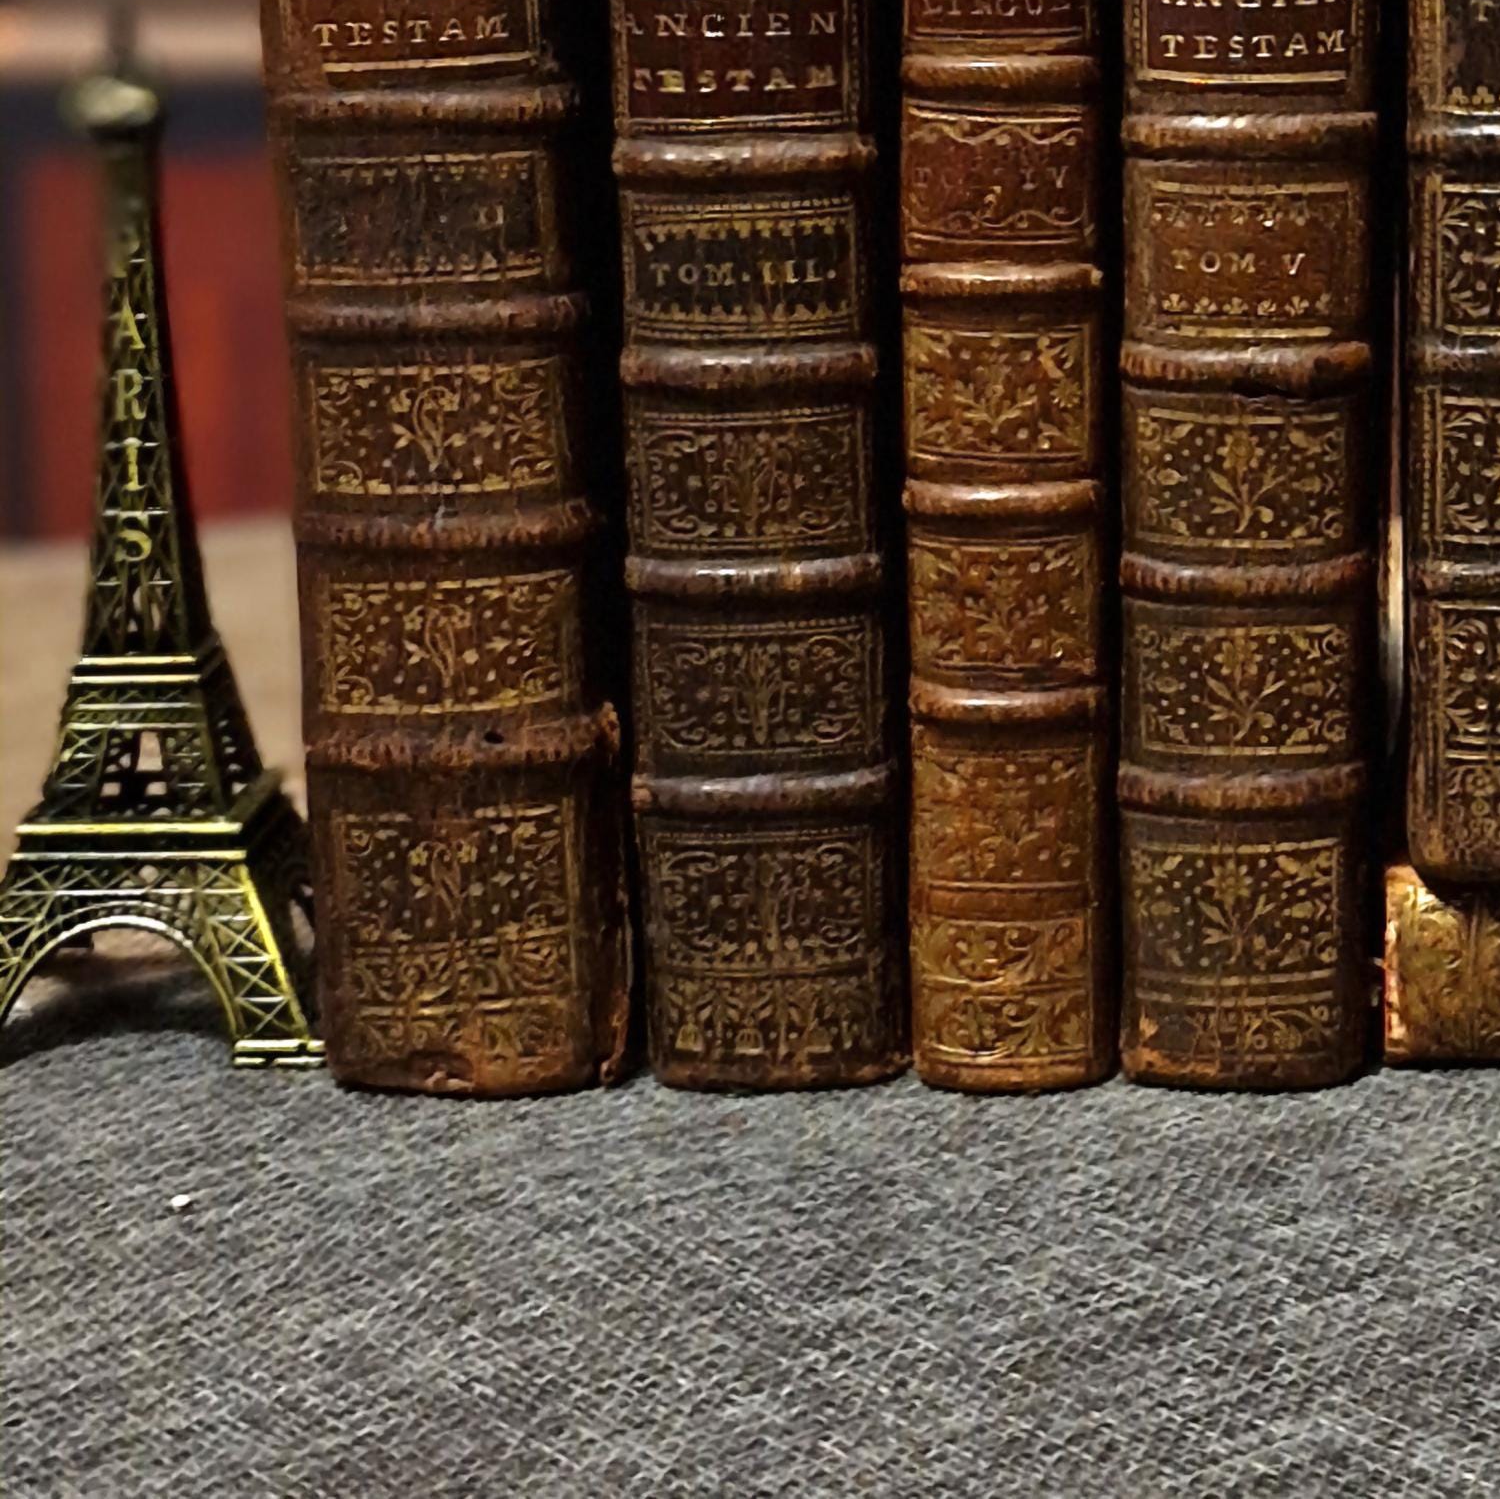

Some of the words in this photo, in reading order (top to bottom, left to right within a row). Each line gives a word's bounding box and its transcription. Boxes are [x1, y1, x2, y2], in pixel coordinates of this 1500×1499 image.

[311, 13, 510, 47] TESTAM
[623, 10, 838, 38] ANCIEN
[1160, 28, 1347, 59] TESTAM
[632, 64, 838, 93] TESTAM
[1170, 251, 1258, 274] TOM
[1284, 252, 1307, 275] V
